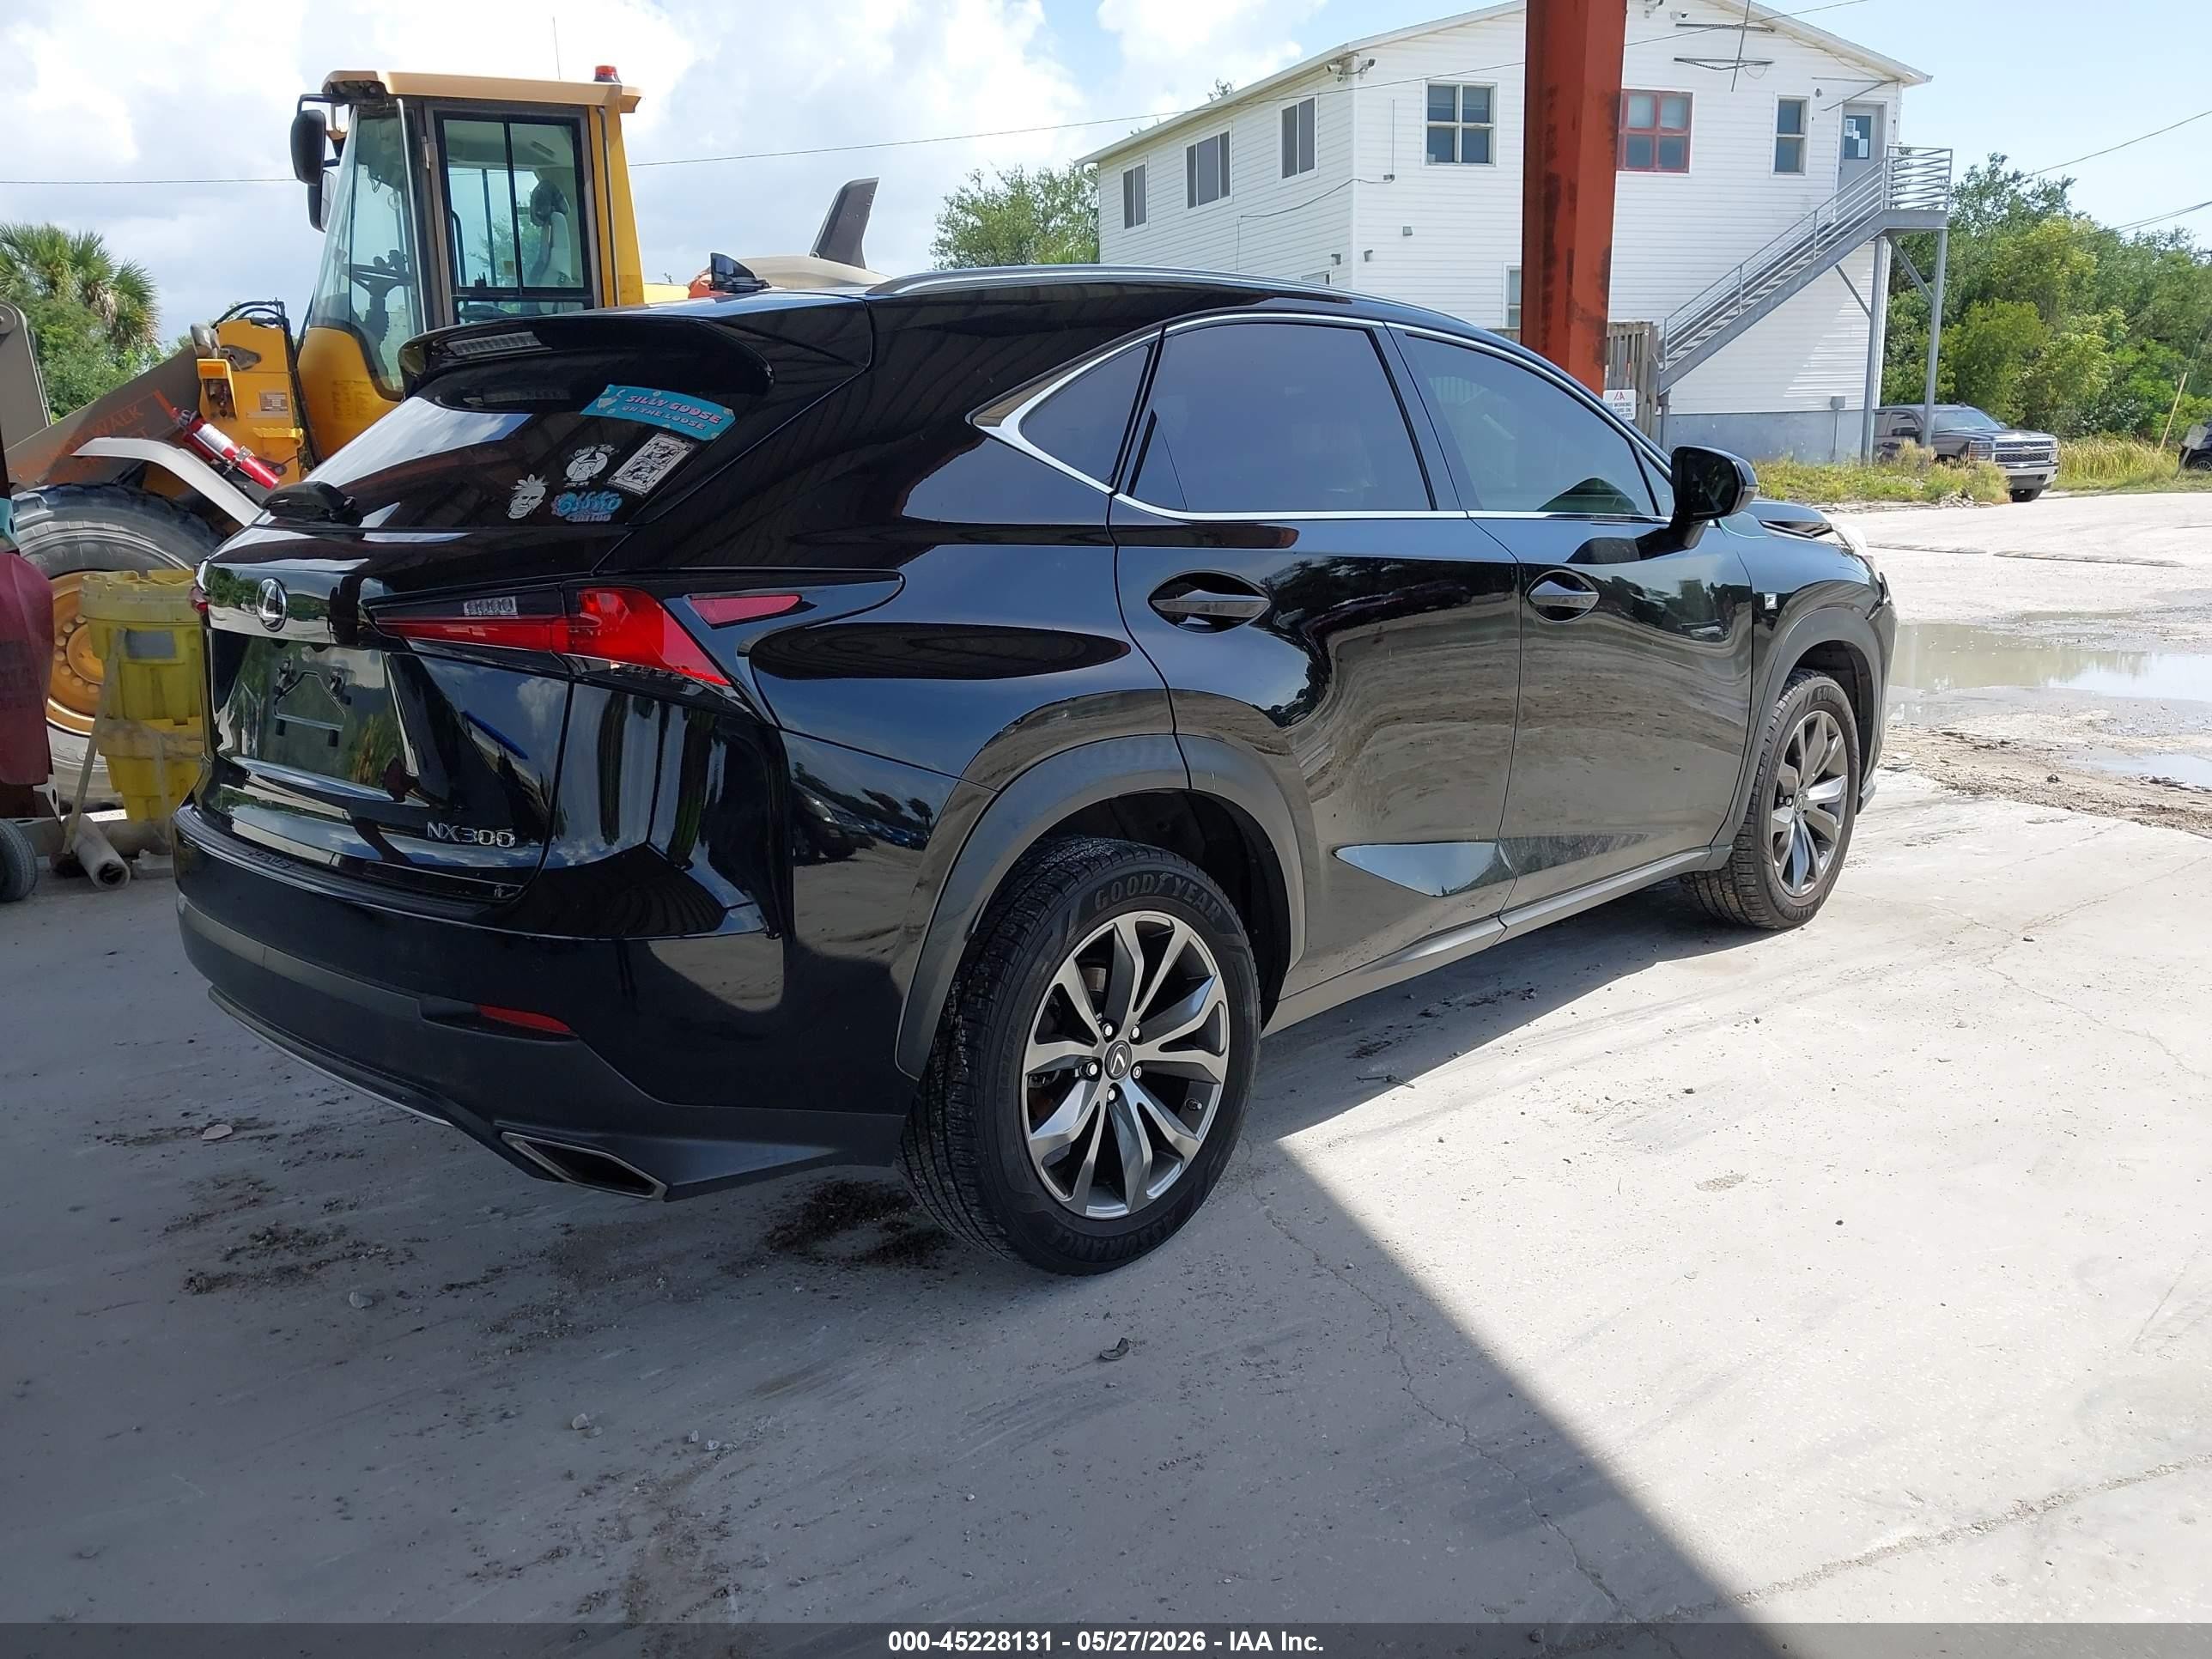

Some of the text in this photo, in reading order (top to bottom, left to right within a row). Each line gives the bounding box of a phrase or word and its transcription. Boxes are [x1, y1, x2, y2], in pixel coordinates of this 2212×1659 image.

[625, 395, 722, 425] SILLY GOOSE
[640, 407, 664, 417] THE
[665, 413, 708, 431] LOOSE
[427, 821, 516, 848] NX300
[1094, 872, 1223, 921] GOODYEAR
